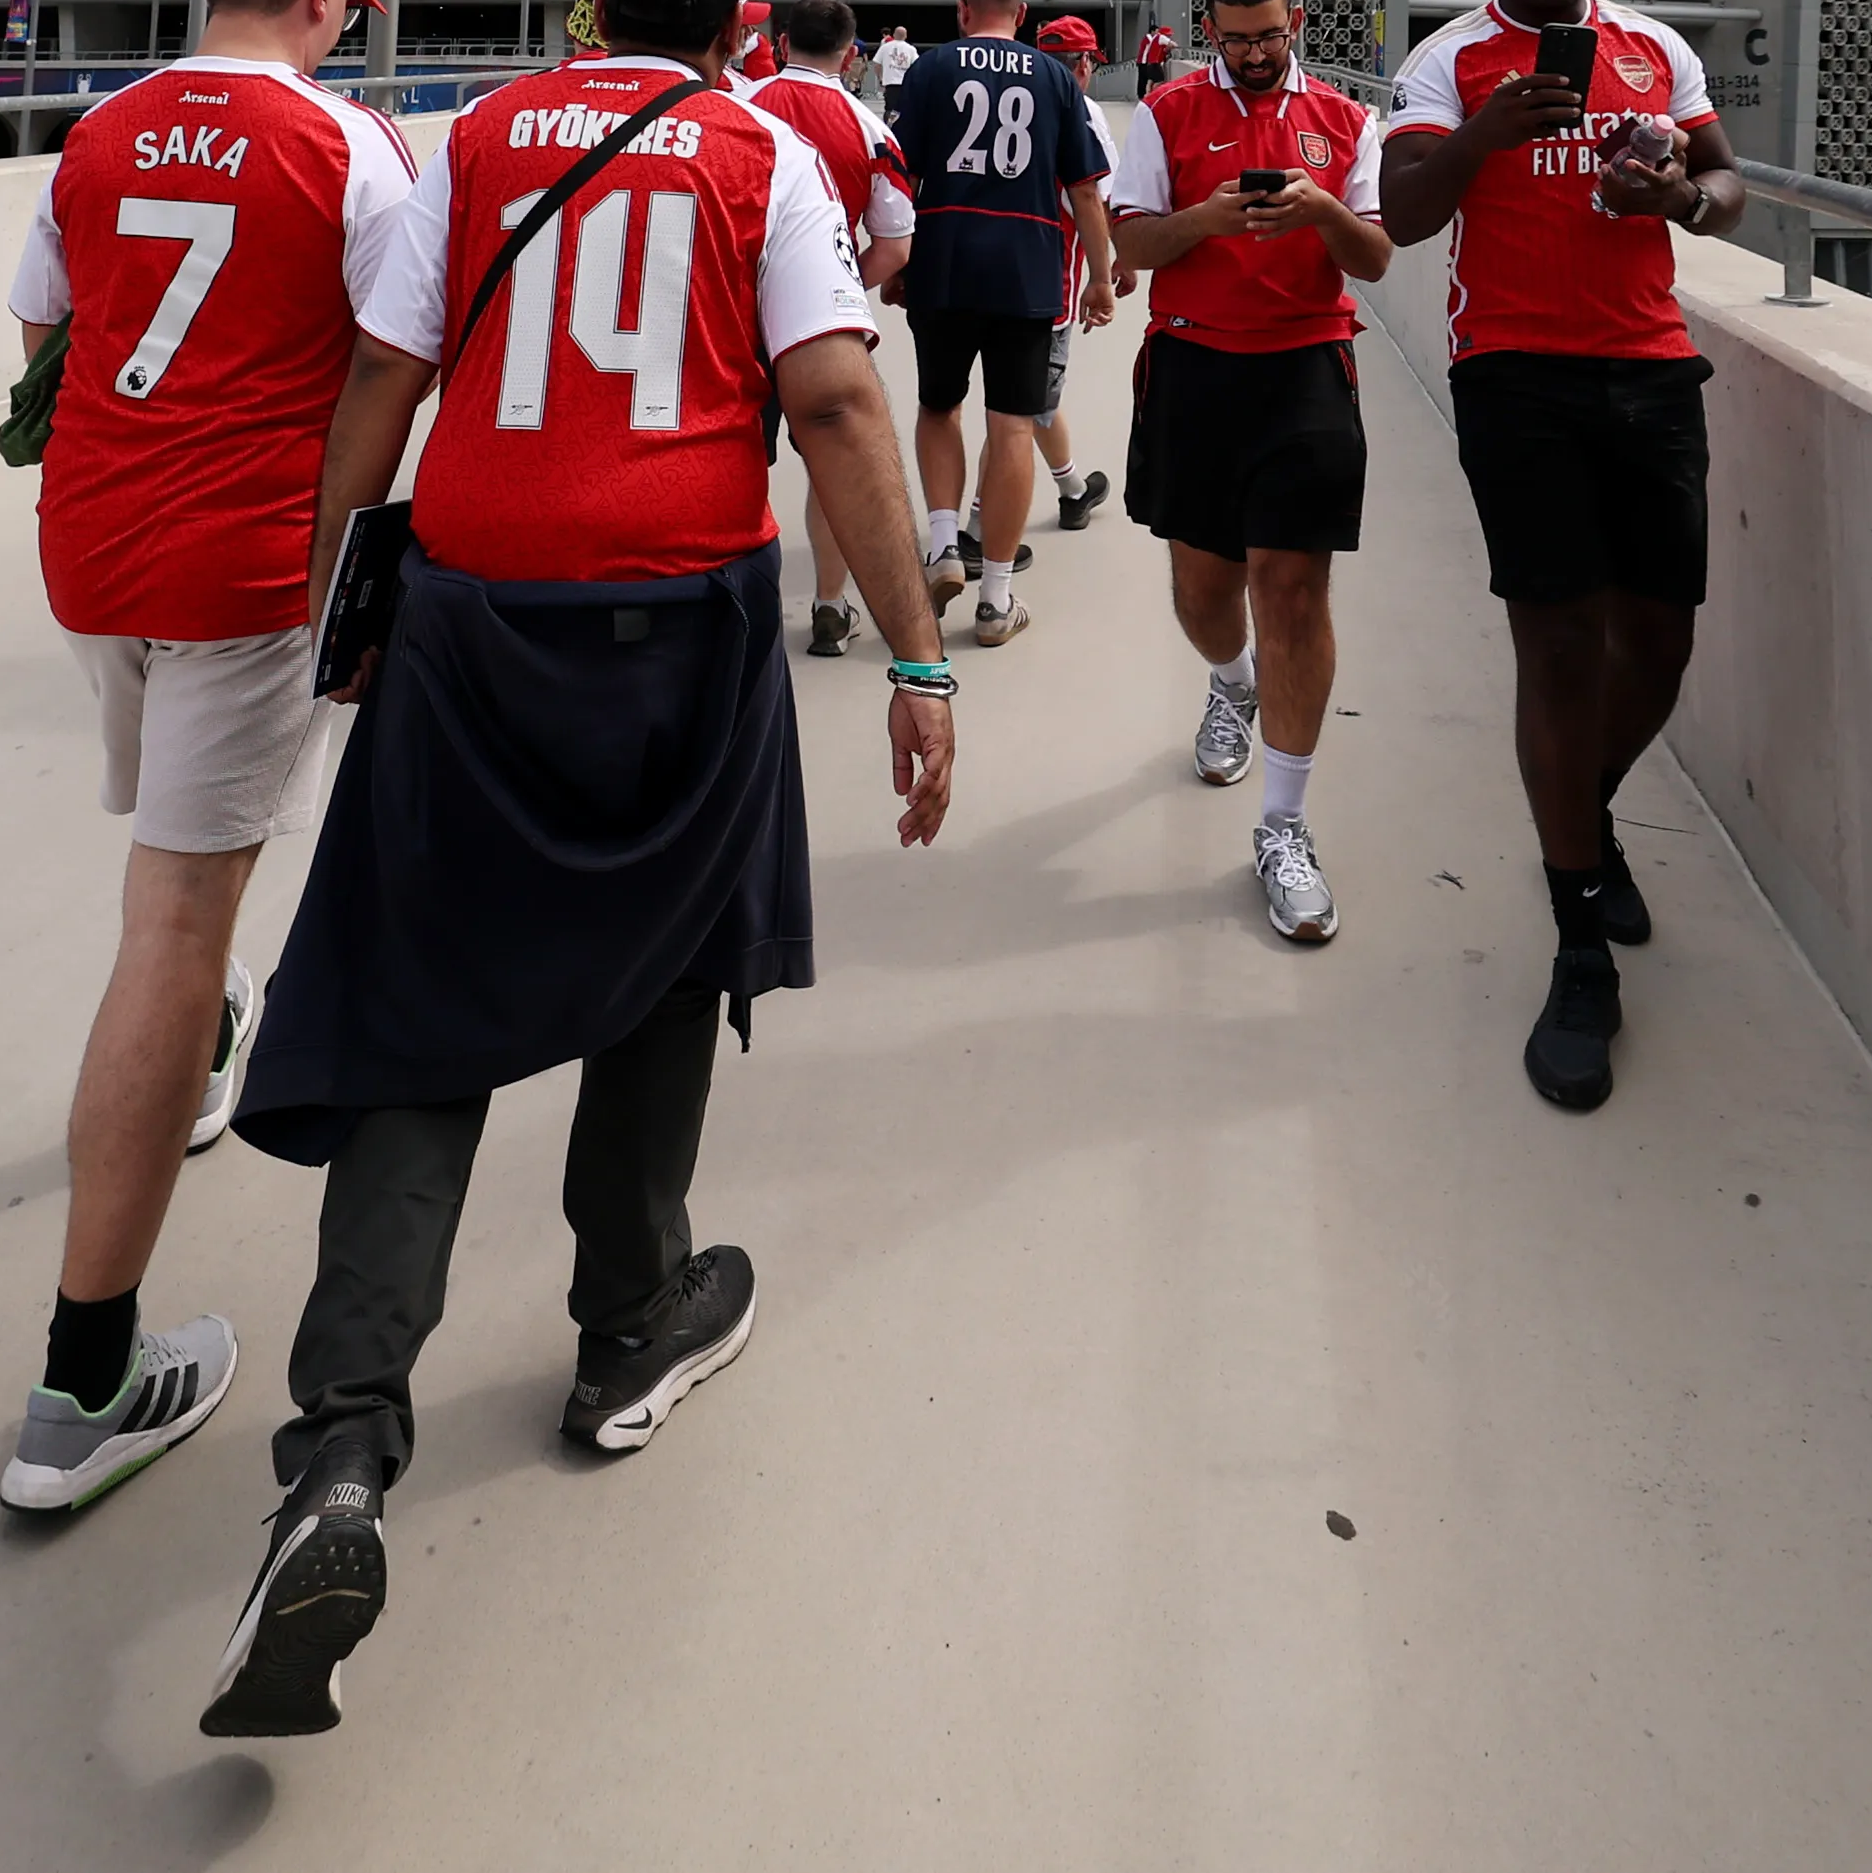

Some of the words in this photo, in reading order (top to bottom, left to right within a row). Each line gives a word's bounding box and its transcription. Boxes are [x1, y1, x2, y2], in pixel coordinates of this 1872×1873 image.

[957, 46, 1033, 76] TOURE
[1745, 28, 1770, 66] C
[178, 90, 230, 105] Arsenal
[581, 79, 640, 92] Arsenal
[947, 79, 1035, 179] 28
[134, 125, 249, 179] SAKA
[1533, 146, 1569, 176] FLY
[114, 197, 237, 400] 7
[496, 189, 699, 430] 14
[325, 1482, 370, 1509] NIKE
